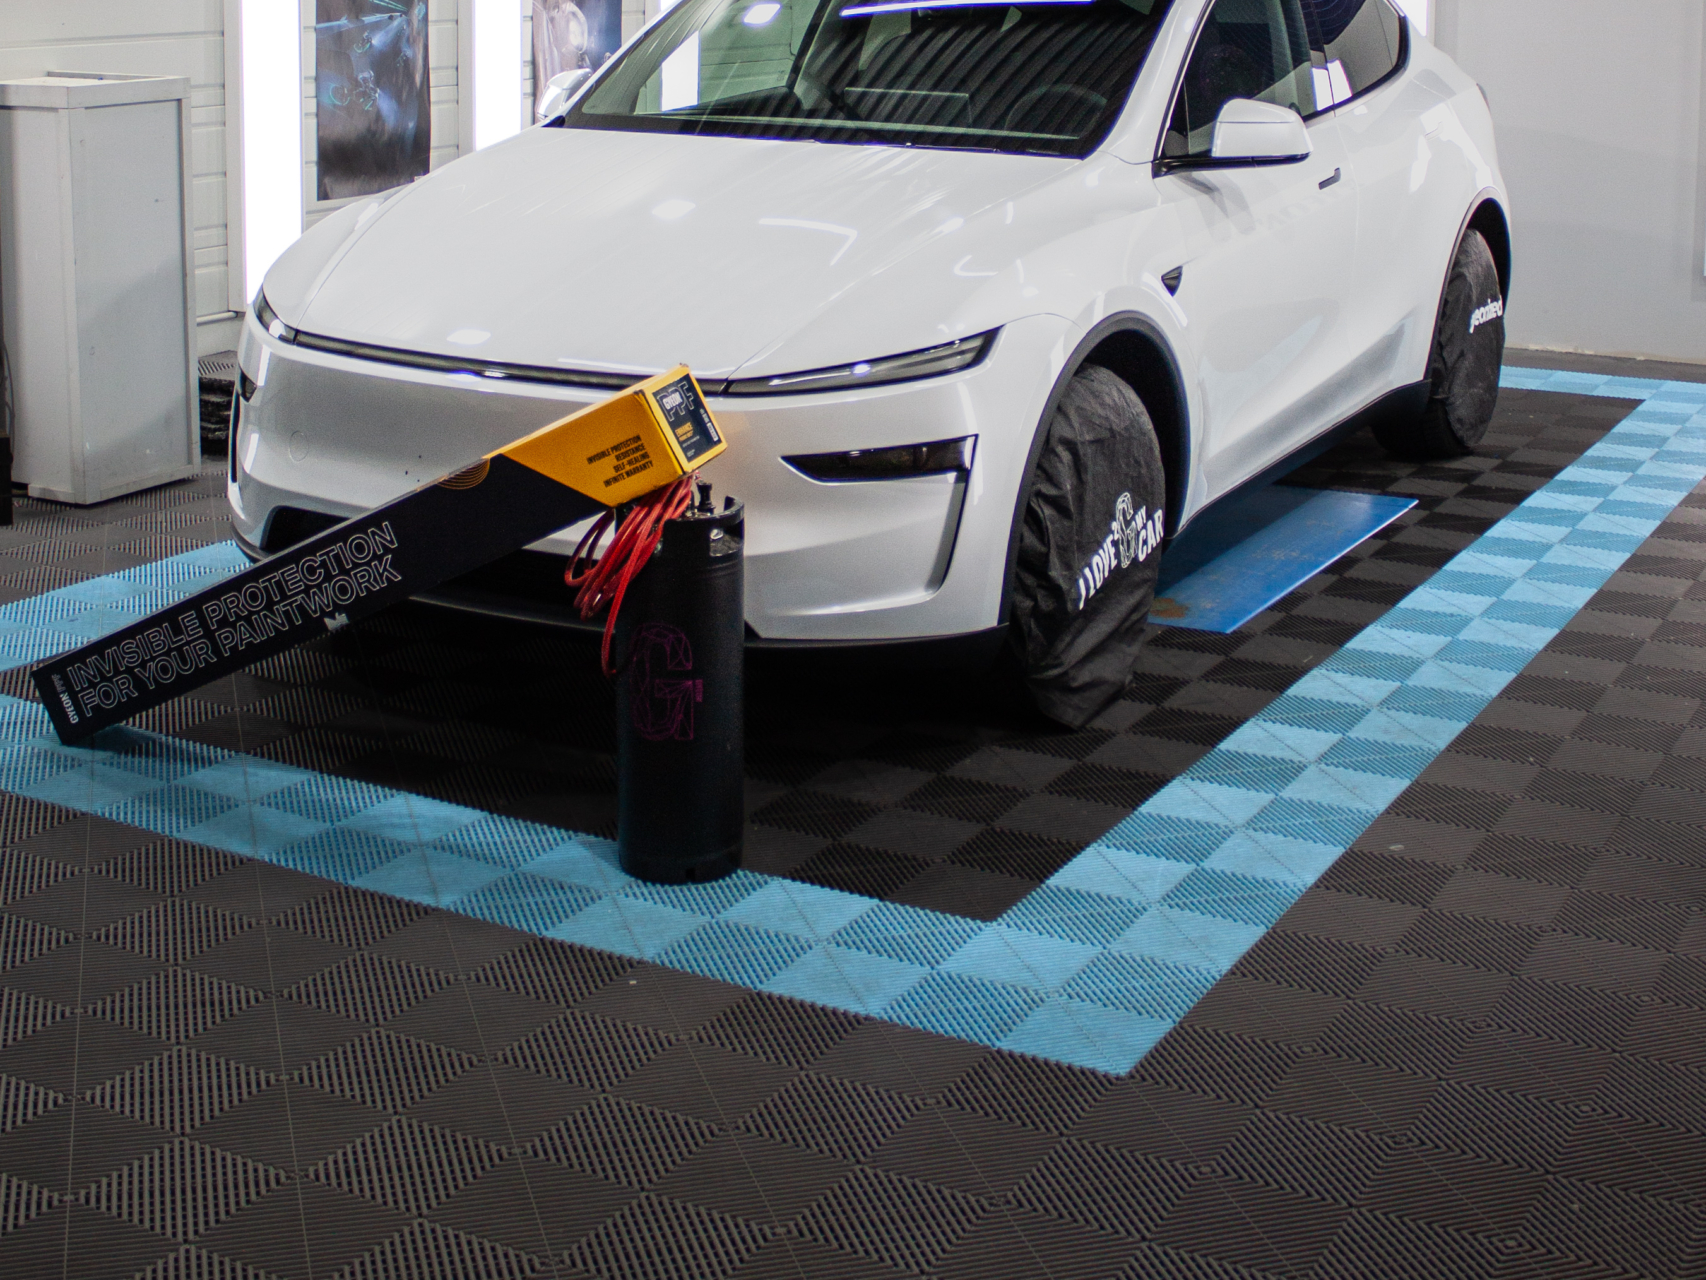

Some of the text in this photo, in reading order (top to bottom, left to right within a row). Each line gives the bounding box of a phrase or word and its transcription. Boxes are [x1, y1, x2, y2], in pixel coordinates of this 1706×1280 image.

[610, 434, 642, 454] PROTECTION
[614, 442, 646, 462] RESISTANCE
[624, 460, 654, 478] WARRANTY
[1135, 505, 1147, 532] MY
[1138, 509, 1164, 562] CAR
[1083, 533, 1118, 599] LOVE
[67, 521, 398, 691] INVISIBLE PROTECTION
[78, 554, 402, 717] FOR YOUR PAINTWORK
[59, 692, 79, 724] GYEON
